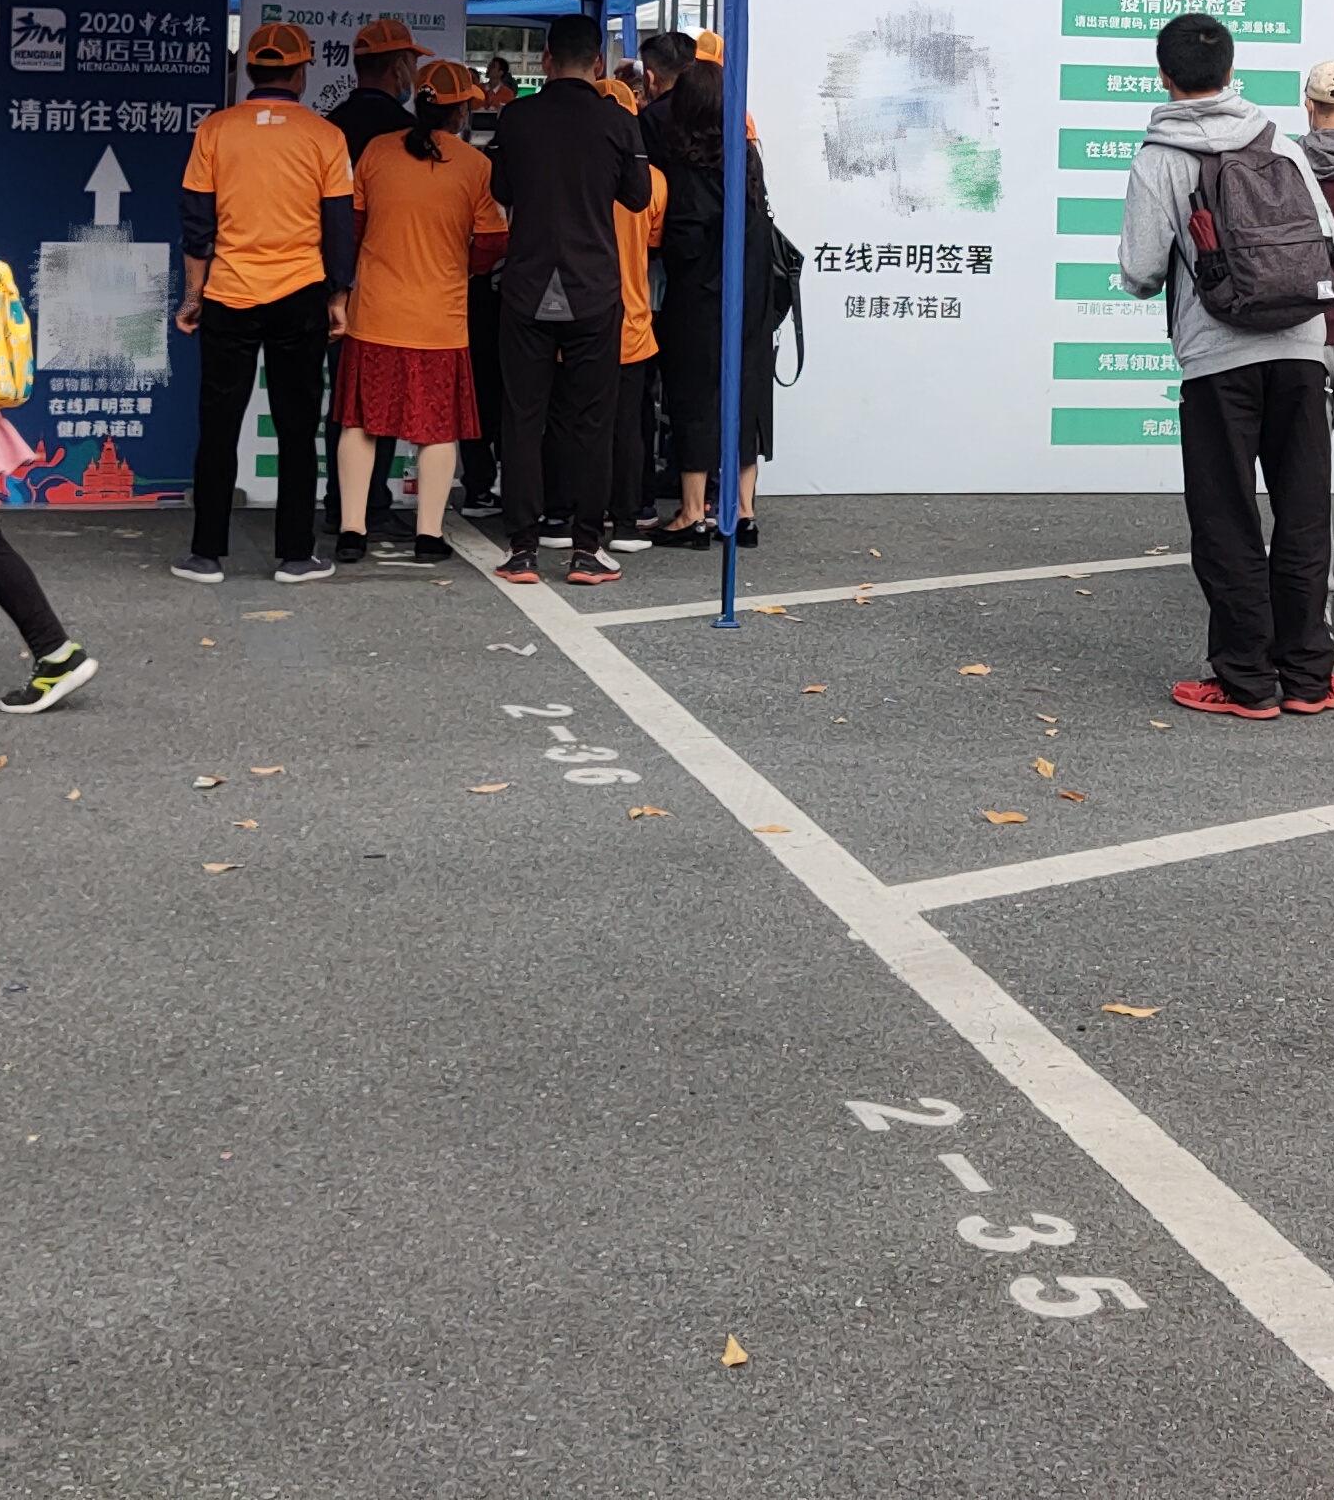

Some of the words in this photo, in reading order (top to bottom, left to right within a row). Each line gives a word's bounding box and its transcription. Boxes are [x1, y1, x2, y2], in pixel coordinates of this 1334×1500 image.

[79, 11, 135, 35] 2020
[287, 10, 324, 26] 2020
[76, 38, 212, 65] 横店马拉松
[77, 62, 140, 74] HENGDIAN
[143, 63, 210, 75] MARATHON
[8, 98, 216, 134] 请前往领物区
[814, 243, 994, 276] 在线声明签署
[844, 295, 962, 320] 健康承诺函
[48, 398, 153, 415] 在线声明签署
[56, 420, 144, 438] 健康承诺函
[844, 1096, 1149, 1319] 2-35
